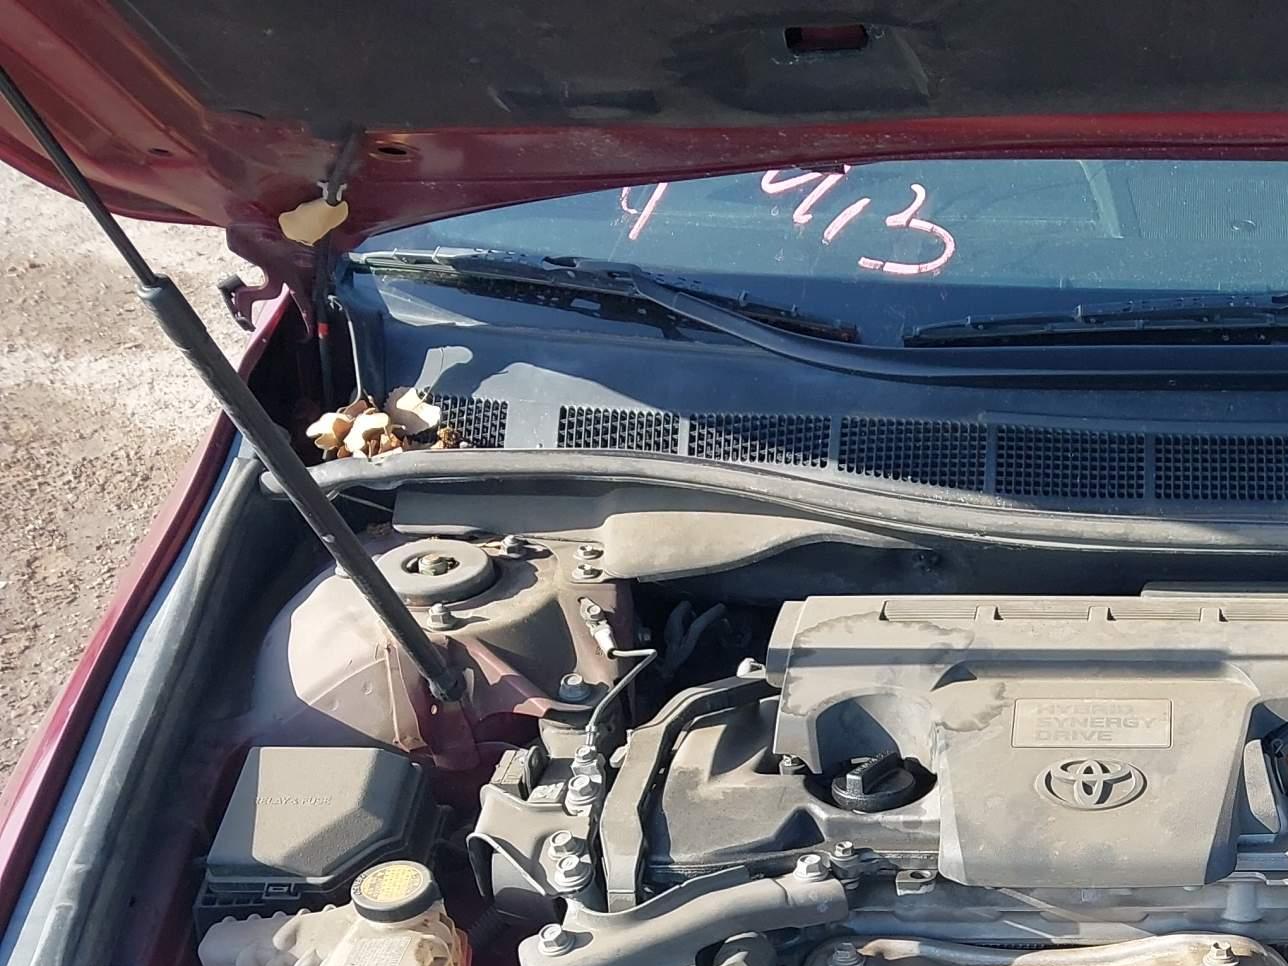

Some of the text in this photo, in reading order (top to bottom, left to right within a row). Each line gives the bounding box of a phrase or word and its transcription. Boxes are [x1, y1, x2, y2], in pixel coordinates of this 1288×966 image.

[1036, 703, 1136, 715] HYBRID
[1036, 716, 1157, 729] SYNERGY
[1036, 730, 1114, 742] DRIVE
